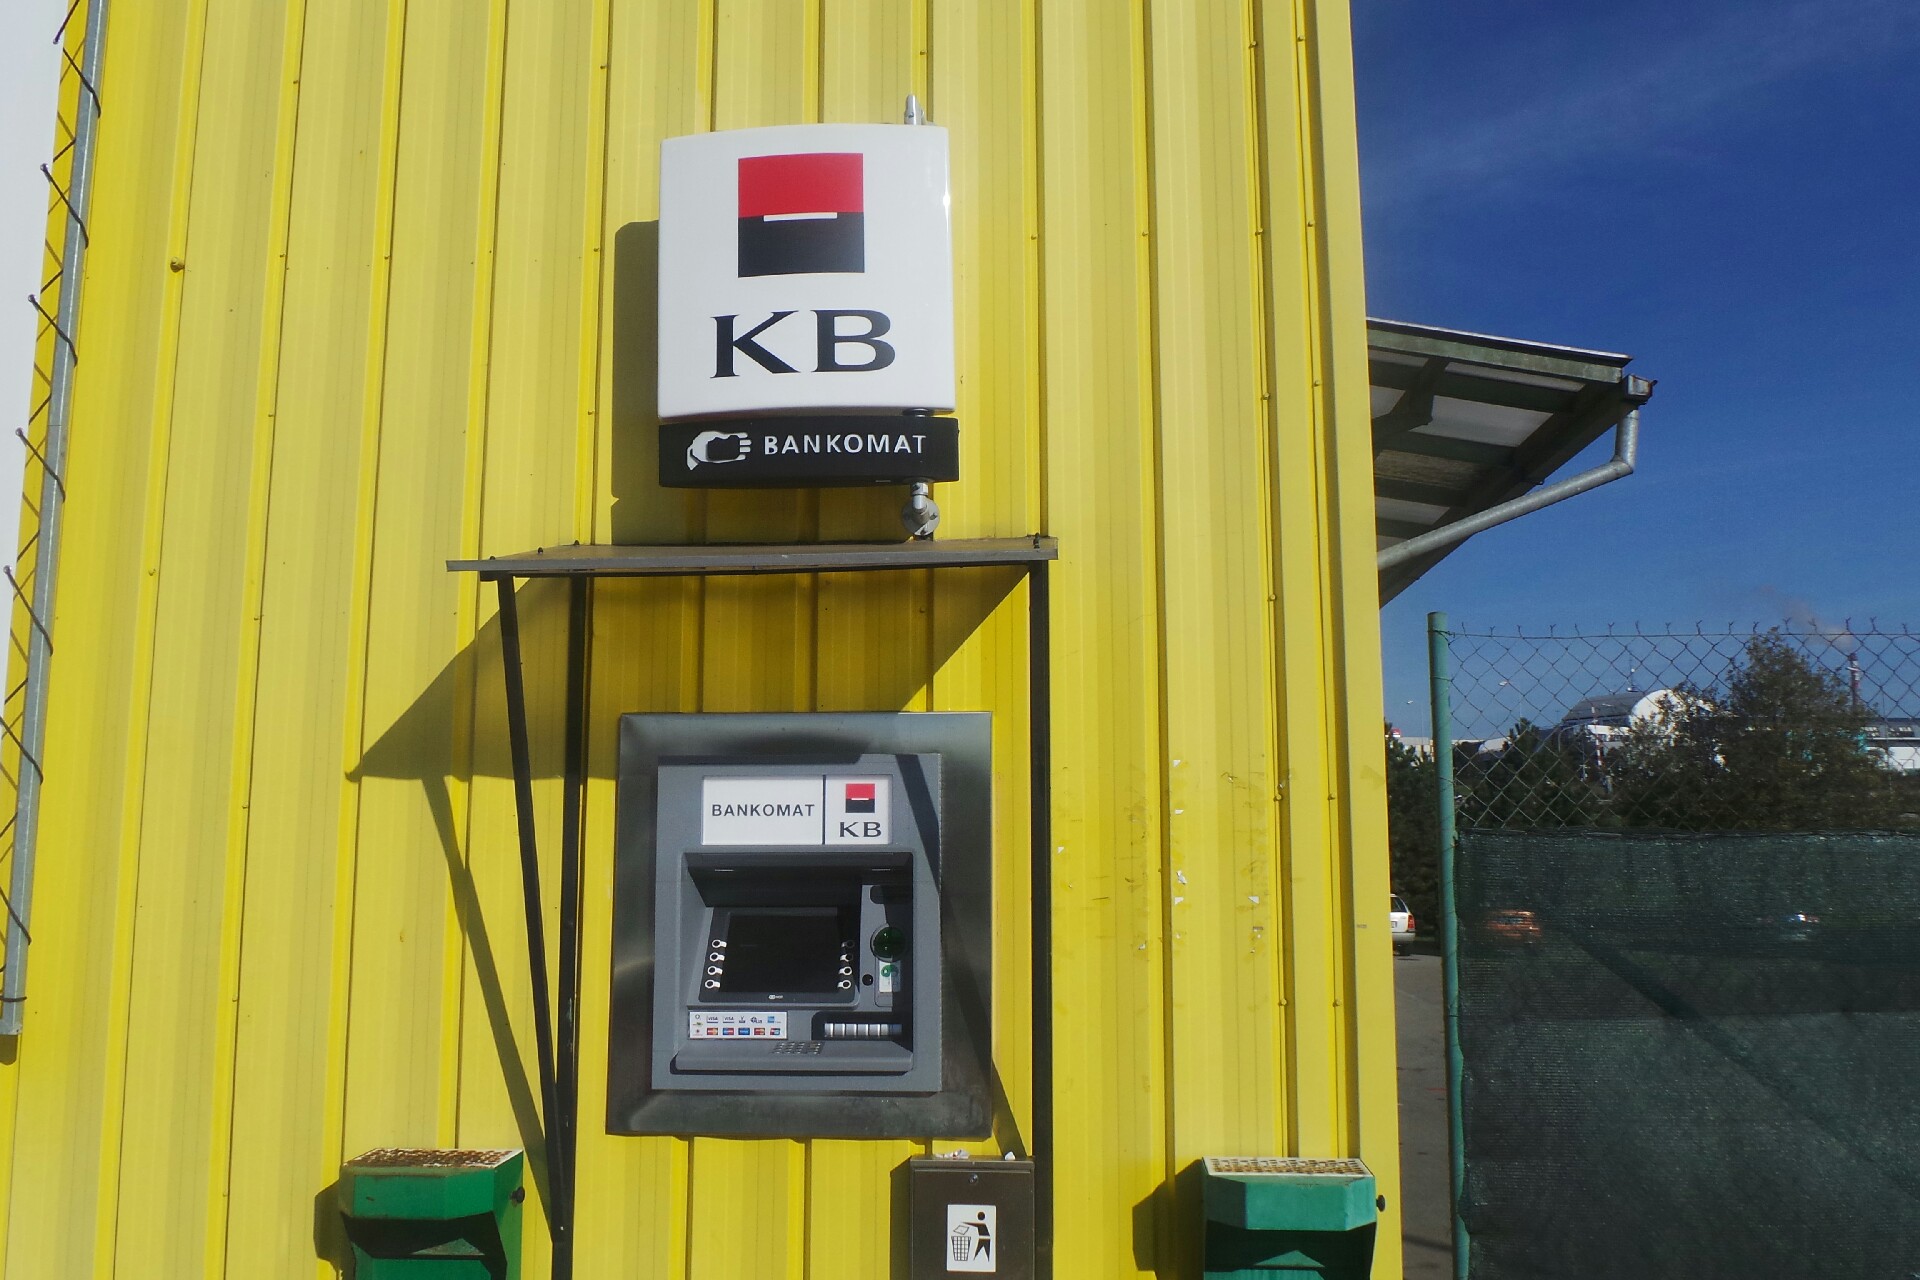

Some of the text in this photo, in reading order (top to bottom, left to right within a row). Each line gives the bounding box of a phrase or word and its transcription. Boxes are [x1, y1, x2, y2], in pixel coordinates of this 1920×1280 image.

[710, 309, 896, 379] KB
[763, 433, 927, 455] BANKOMAT
[711, 803, 816, 817] BANKOMAT
[838, 821, 883, 838] KB
